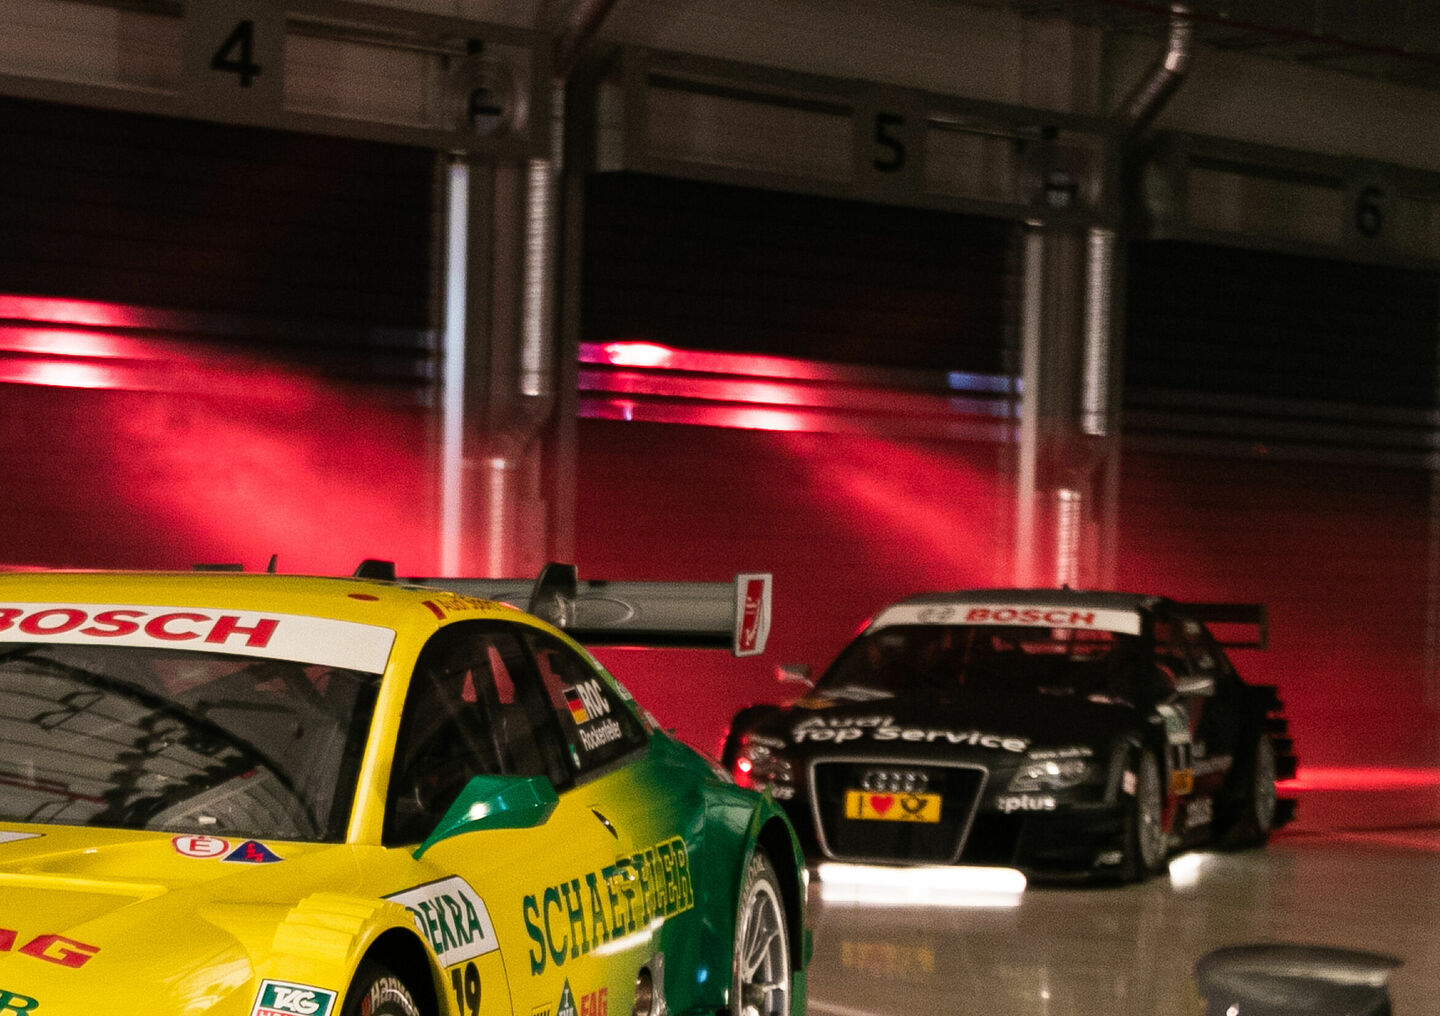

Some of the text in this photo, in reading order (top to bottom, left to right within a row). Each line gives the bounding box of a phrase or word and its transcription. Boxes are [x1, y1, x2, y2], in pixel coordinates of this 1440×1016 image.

[211, 20, 261, 88] 4
[873, 112, 907, 173] 5
[1356, 185, 1385, 238] 6
[964, 606, 1096, 628] BOSCH
[576, 679, 610, 720] ROC
[793, 724, 863, 744] Top
[873, 725, 1030, 753] Service
[523, 836, 694, 977] SCHAEFFLER
[273, 986, 320, 1015] TAG
